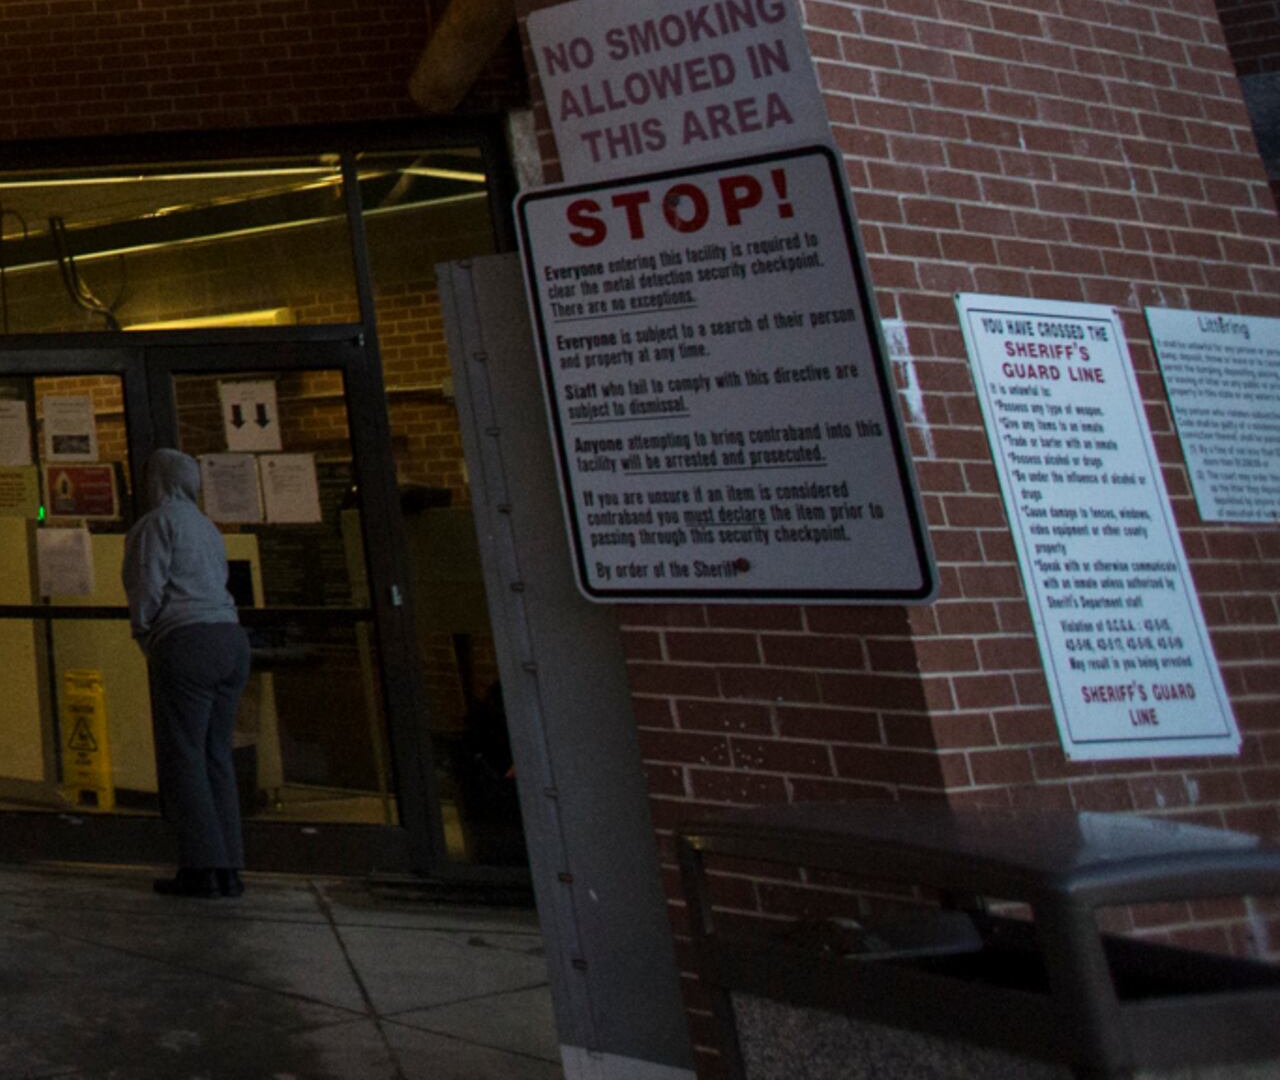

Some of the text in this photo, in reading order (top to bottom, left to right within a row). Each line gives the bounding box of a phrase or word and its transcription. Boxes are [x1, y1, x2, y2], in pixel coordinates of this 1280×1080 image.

[542, 36, 594, 76] NO
[559, 39, 790, 121] ALLOWED IN
[581, 93, 793, 163] THIS AREA
[566, 168, 795, 248] STOP!
[543, 232, 818, 281] Everyone entering this facility is required to
[548, 251, 823, 299] clear the metal detection security checkpoint.
[550, 290, 695, 316] There are no exceptions.
[556, 308, 855, 350] Everyone is subject to a search of their person
[981, 318, 1108, 342] YOU HAVE CROSSED THE
[559, 343, 709, 369] and property at any time.
[1004, 340, 1090, 361] SHERIFF'S
[564, 364, 858, 400] Staff who fail to comply with this directive are
[1001, 362, 1104, 383] GUARD LINE
[568, 395, 688, 420] subject to dismissal.
[574, 420, 882, 456] Anyone attempting to bring contraband into this
[576, 444, 825, 472] facility will be arrested and prosecuted.
[582, 480, 849, 508] If you are unsure if an item is considered
[587, 502, 884, 526] contraband you must declare the item prior to
[590, 524, 850, 547] passing through this security checkpoint.
[595, 559, 740, 580] By order of the Sheriff
[1081, 681, 1195, 703] SHERIFF'S GUARD
[1128, 707, 1159, 726] LINE
